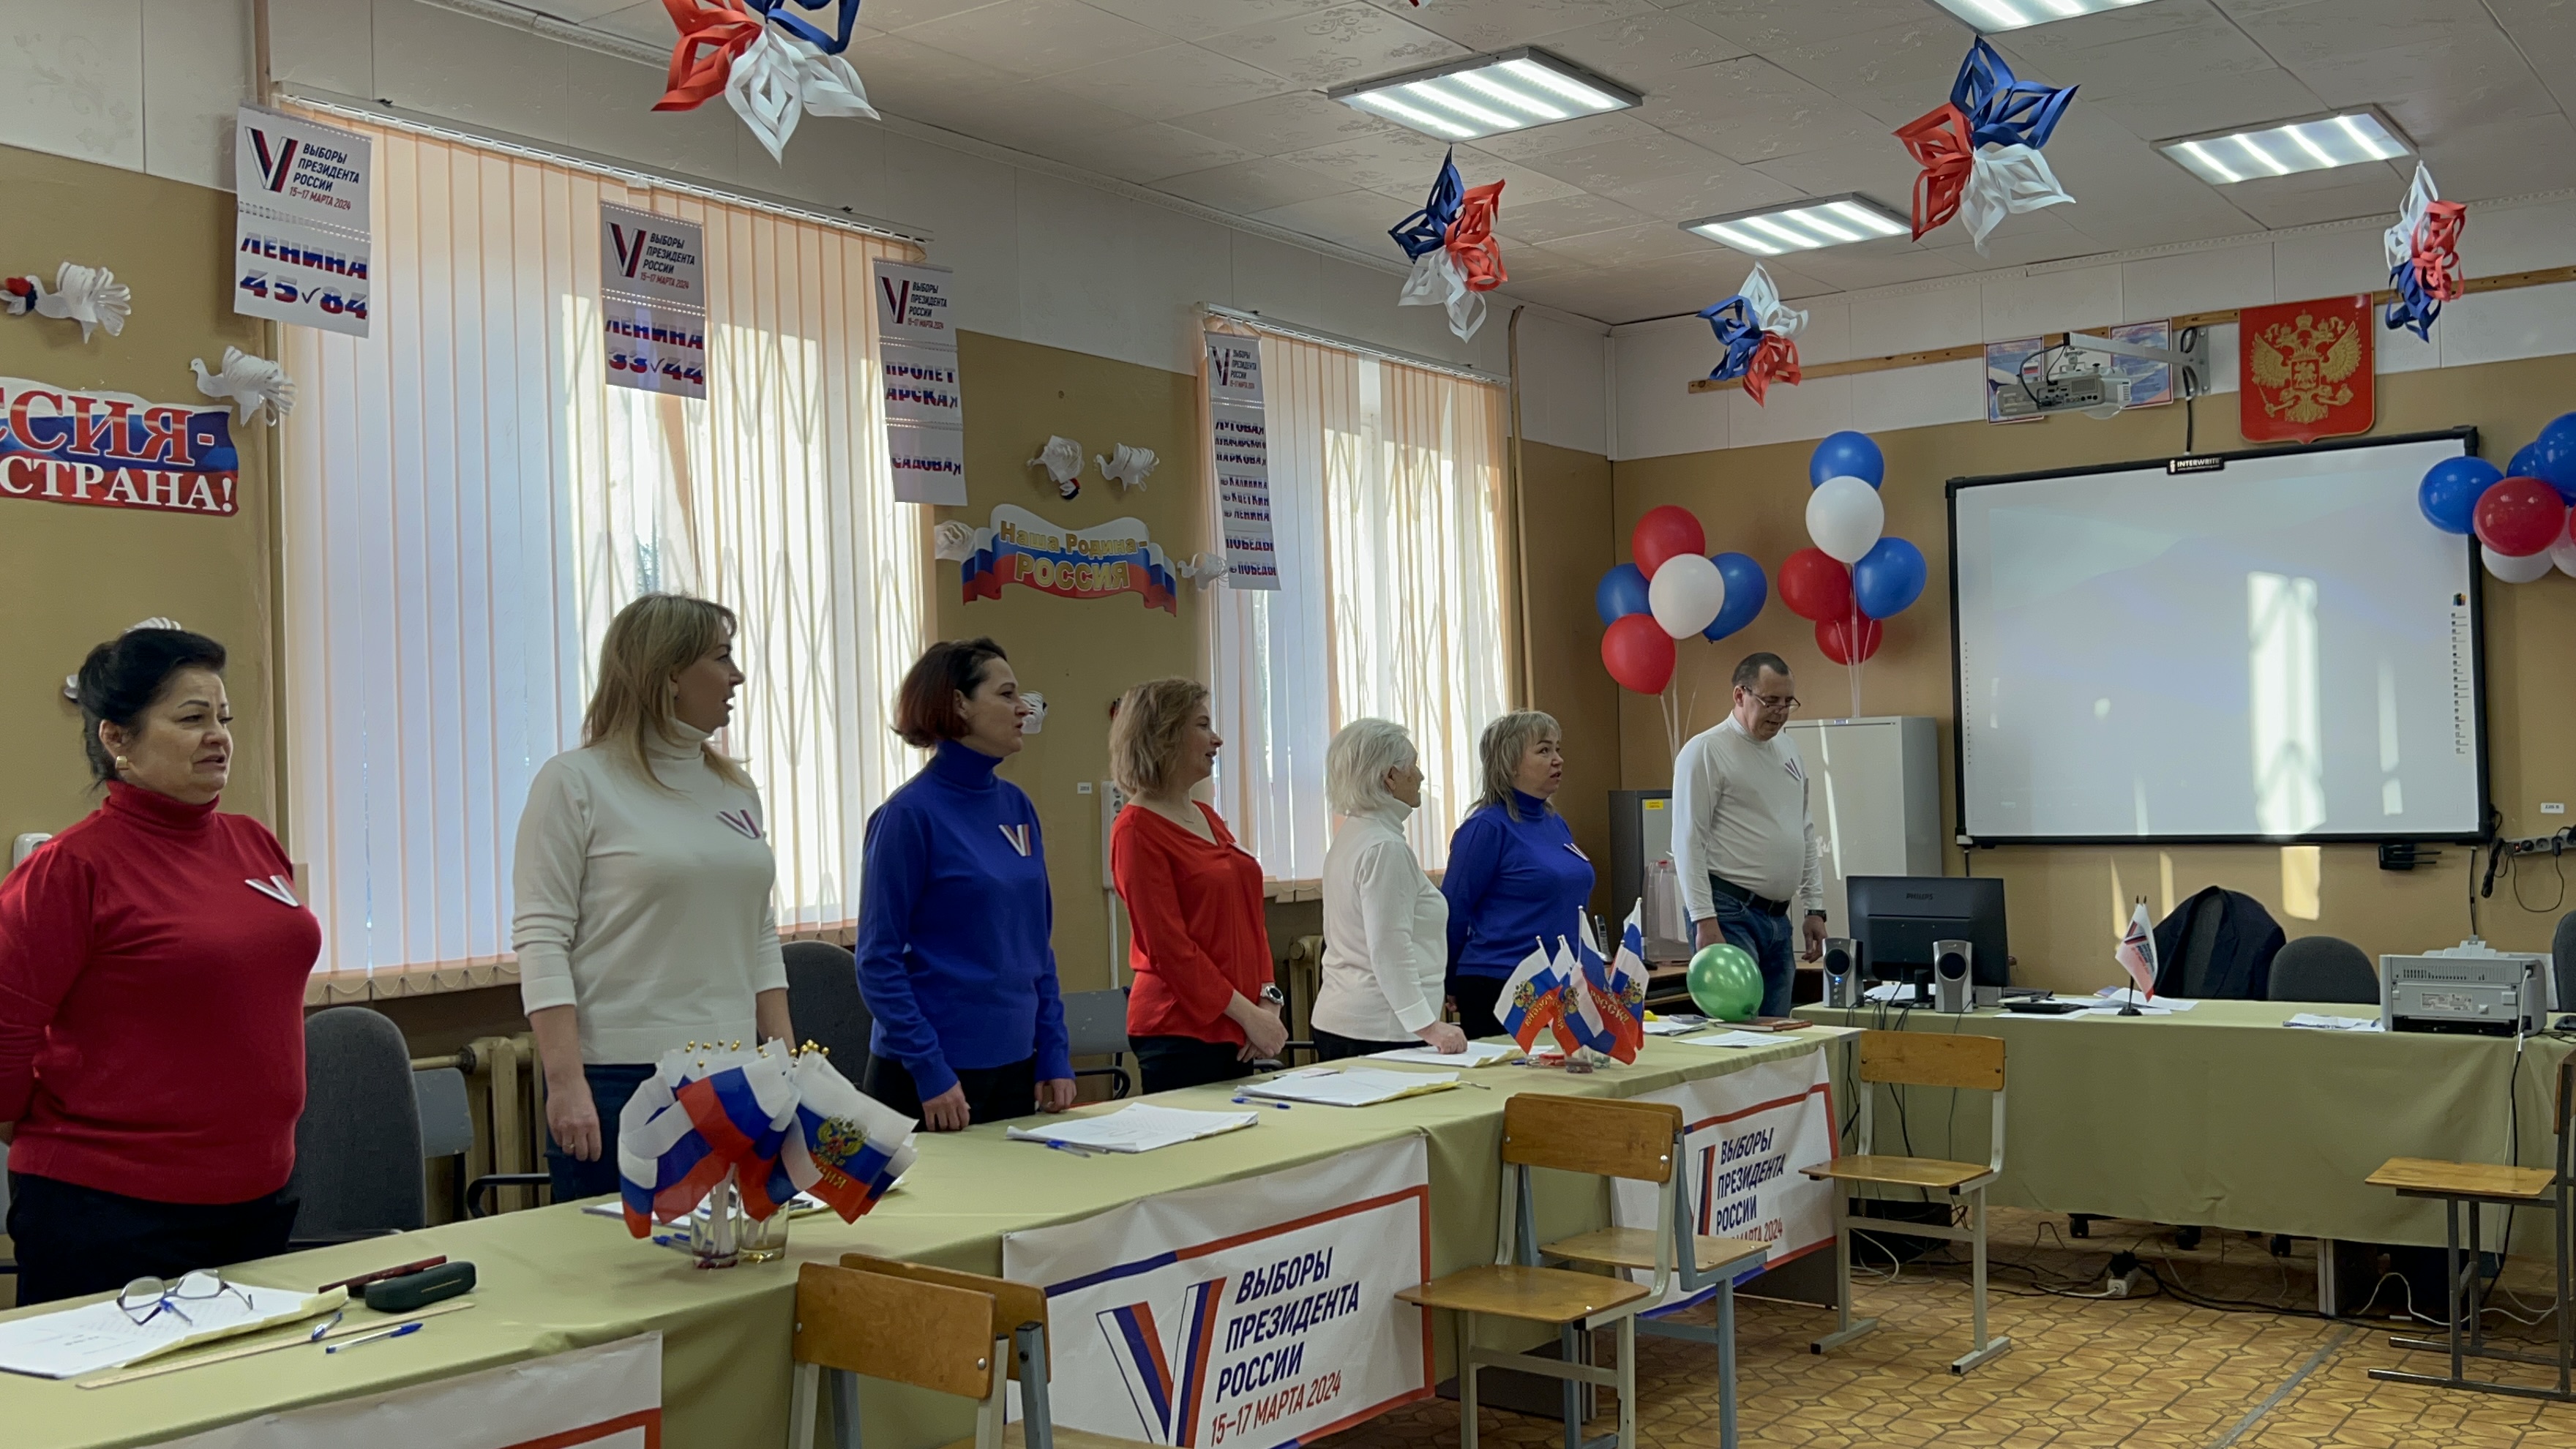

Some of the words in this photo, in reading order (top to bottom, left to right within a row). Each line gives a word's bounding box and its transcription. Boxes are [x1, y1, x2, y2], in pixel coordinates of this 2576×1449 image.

[303, 143, 348, 165] ВЫБОРЫ
[293, 173, 333, 192] РОССИИ
[298, 158, 360, 184] ПРЕЗИДЕНТА
[310, 193, 334, 206] МАРТА
[333, 198, 351, 211] 2024
[650, 233, 685, 250] ВЫБОРЫ
[240, 232, 367, 280] ЛЕНИНА
[643, 259, 675, 274] РОССИИ
[646, 246, 695, 266] ПРЕЗИДЕНТА
[656, 276, 675, 287] МАРТА
[675, 279, 689, 289] 2024
[912, 282, 938, 293] ВЫБОРЫ
[908, 306, 932, 318] РОССИИ
[910, 294, 947, 307] ПРЕЗИДЕНТА
[605, 315, 703, 350] ЛЕНИНА
[886, 361, 955, 383] ПРОЛЕТ
[885, 382, 958, 409] АРСКАЯ
[0, 386, 214, 466] СИЯ-
[891, 455, 962, 476] САДОВАЯ
[0, 455, 233, 512] СТРАНА!
[1000, 520, 1060, 553] Наша
[1014, 552, 1131, 592] РОССИЯ
[1721, 1127, 1775, 1166] ВЫБОРЫ
[1717, 1153, 1786, 1200] ПРЕЗИДЕНТА
[1716, 1194, 1757, 1235] РОССИИ
[1764, 1217, 1783, 1242] 2024
[1235, 1246, 1333, 1306] ВЫБОРЫ
[1225, 1281, 1360, 1355] ПРЕЗИДЕНТА
[1216, 1341, 1305, 1404] РОССИИ
[1253, 1383, 1306, 1430] МАРТА
[1306, 1369, 1342, 1409] 2024
